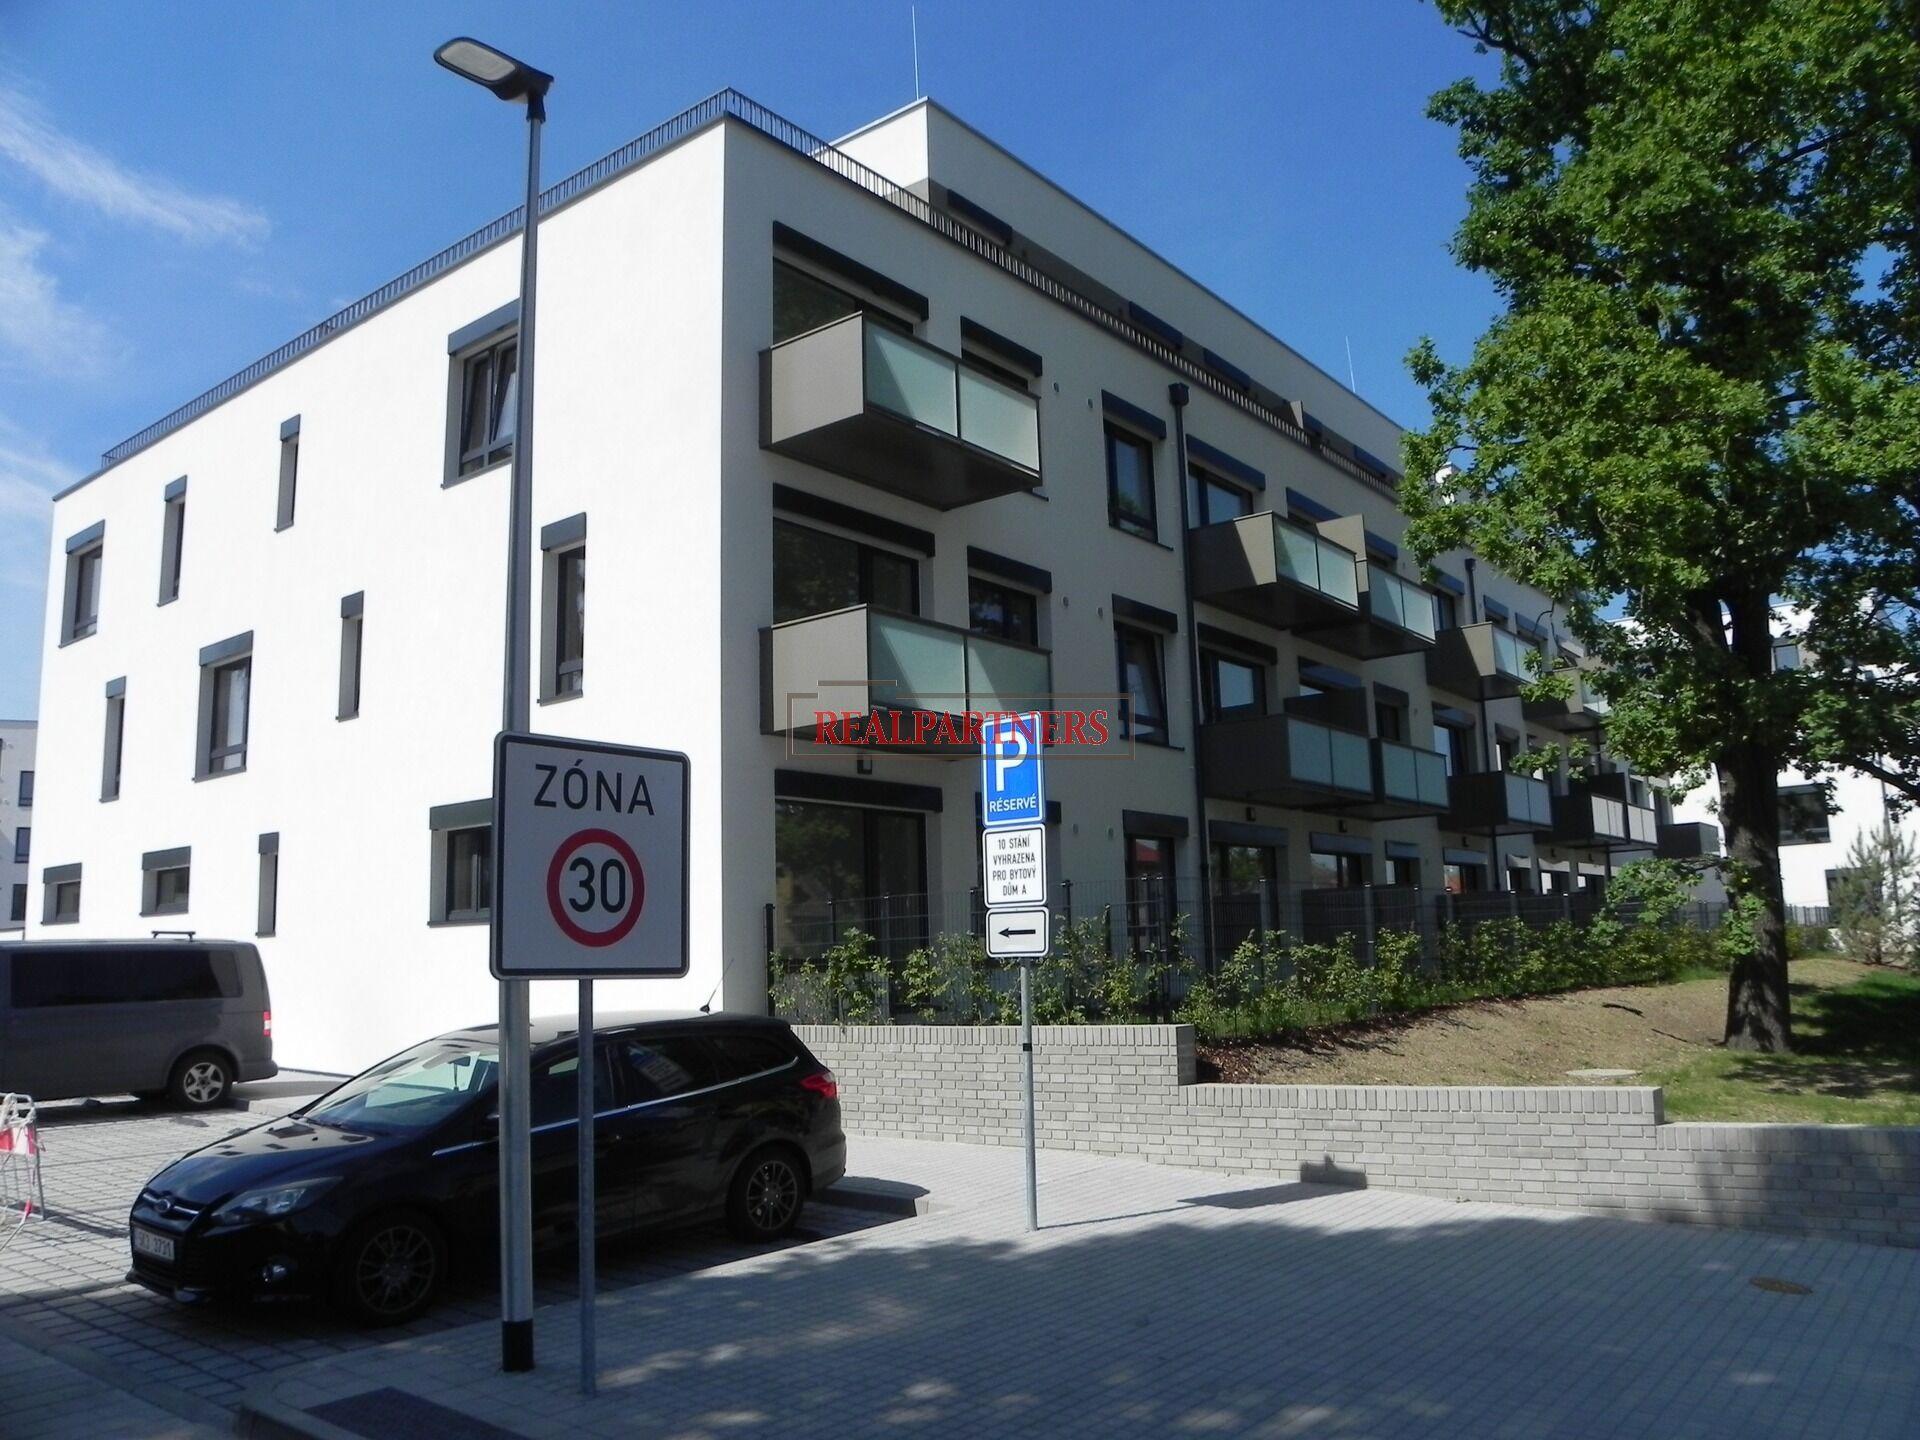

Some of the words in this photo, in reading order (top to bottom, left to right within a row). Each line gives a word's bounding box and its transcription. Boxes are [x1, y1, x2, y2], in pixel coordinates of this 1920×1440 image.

[995, 731, 1028, 792] P
[534, 759, 655, 816] ZÓNA
[989, 793, 1037, 813] RÉSERVÉ
[998, 838, 1006, 850] 10
[1009, 834, 1030, 849] STÁNÍ
[993, 852, 1036, 866] VYHRAZENA
[992, 869, 1007, 881] PRO
[1009, 864, 1036, 880] BYTOVÝ
[568, 857, 626, 913] 30
[1003, 881, 1018, 896] DŮM
[1021, 884, 1027, 895] A
